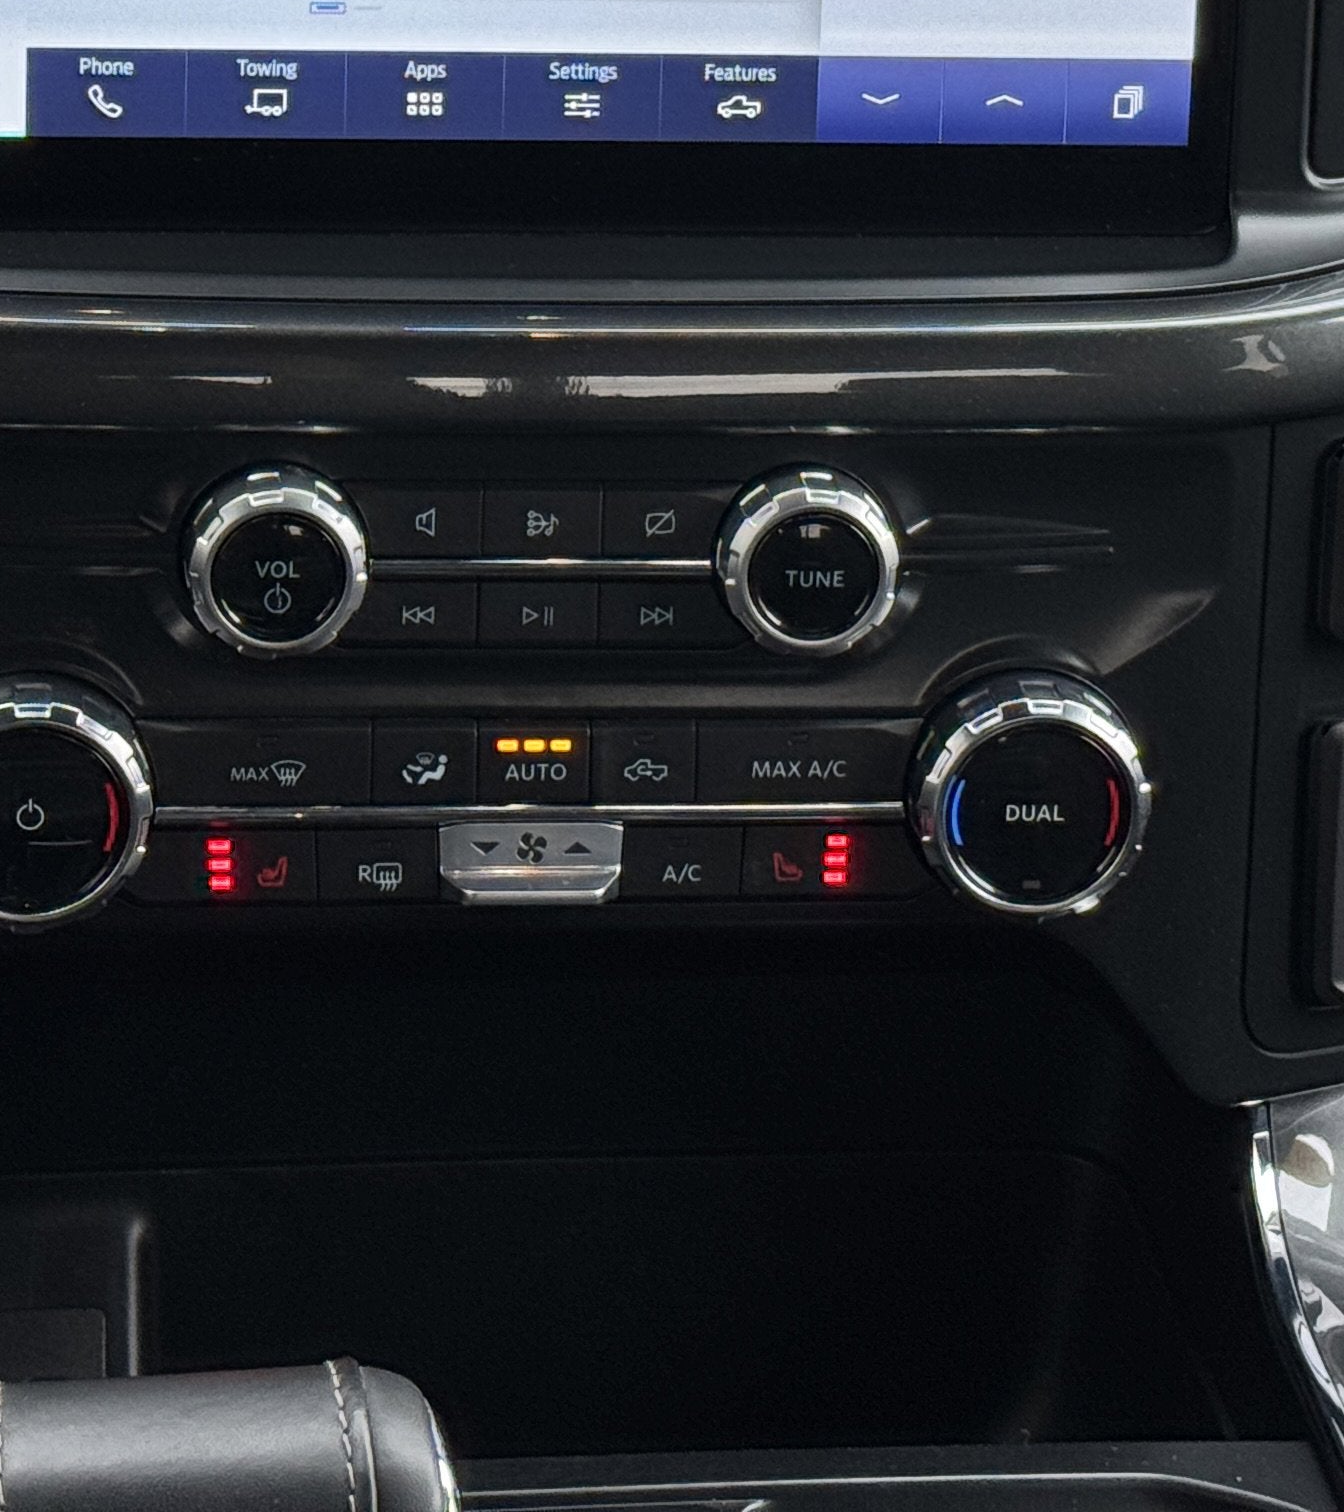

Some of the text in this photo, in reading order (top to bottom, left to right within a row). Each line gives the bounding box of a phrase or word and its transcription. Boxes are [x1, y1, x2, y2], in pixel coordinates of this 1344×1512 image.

[79, 57, 135, 78] Phone
[237, 58, 298, 81] Towing
[404, 61, 447, 82] Apps
[549, 61, 618, 83] Settings
[704, 63, 777, 83] Features
[255, 561, 300, 580] VOL
[785, 570, 845, 589] TUNE
[230, 764, 269, 783] MAX
[504, 762, 567, 782] AUTO
[752, 759, 847, 781] MAX A/C
[1005, 804, 1065, 822] DUAL
[358, 865, 371, 884] R
[662, 864, 702, 883] A/C
